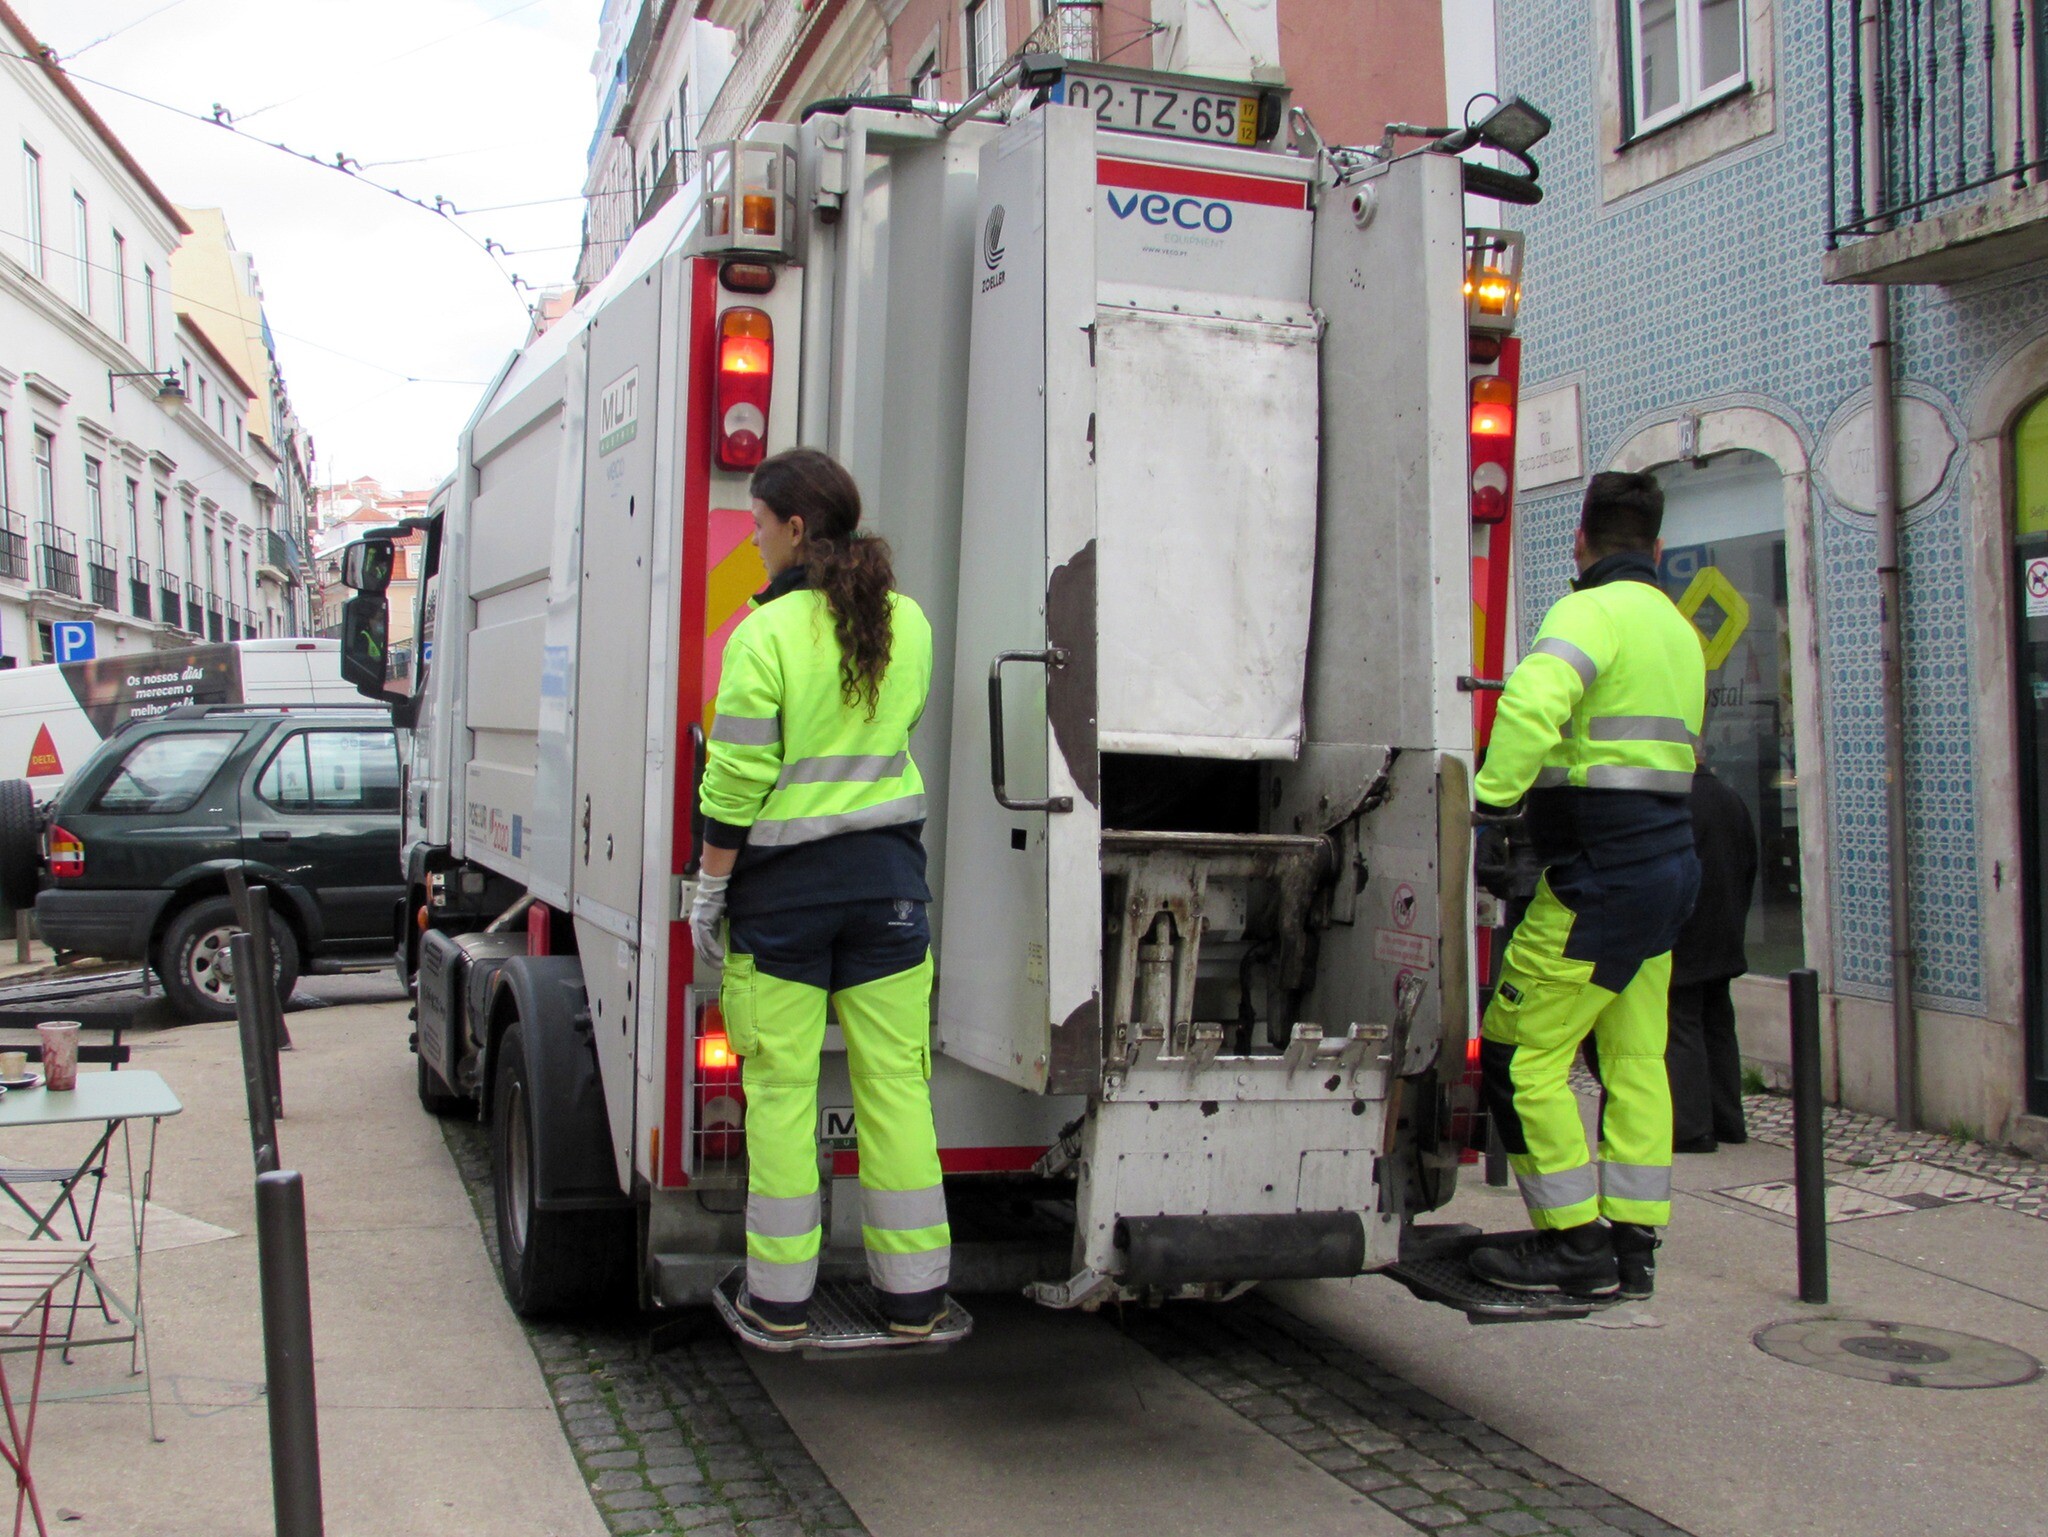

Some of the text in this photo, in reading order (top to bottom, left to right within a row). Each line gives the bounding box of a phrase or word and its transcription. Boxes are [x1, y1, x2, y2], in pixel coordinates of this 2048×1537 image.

[1243, 103, 1254, 116] 17
[1241, 127, 1252, 139] 12
[1107, 189, 1232, 233] veco
[1164, 233, 1225, 249] EQUIPMENT
[982, 270, 1005, 293] ZOELLER
[602, 377, 636, 434] MUT
[62, 626, 87, 661] P
[127, 665, 204, 686] Os nossos dias
[136, 684, 193, 699] merecem o
[32, 754, 56, 765] DELTA
[828, 1113, 857, 1135] M
